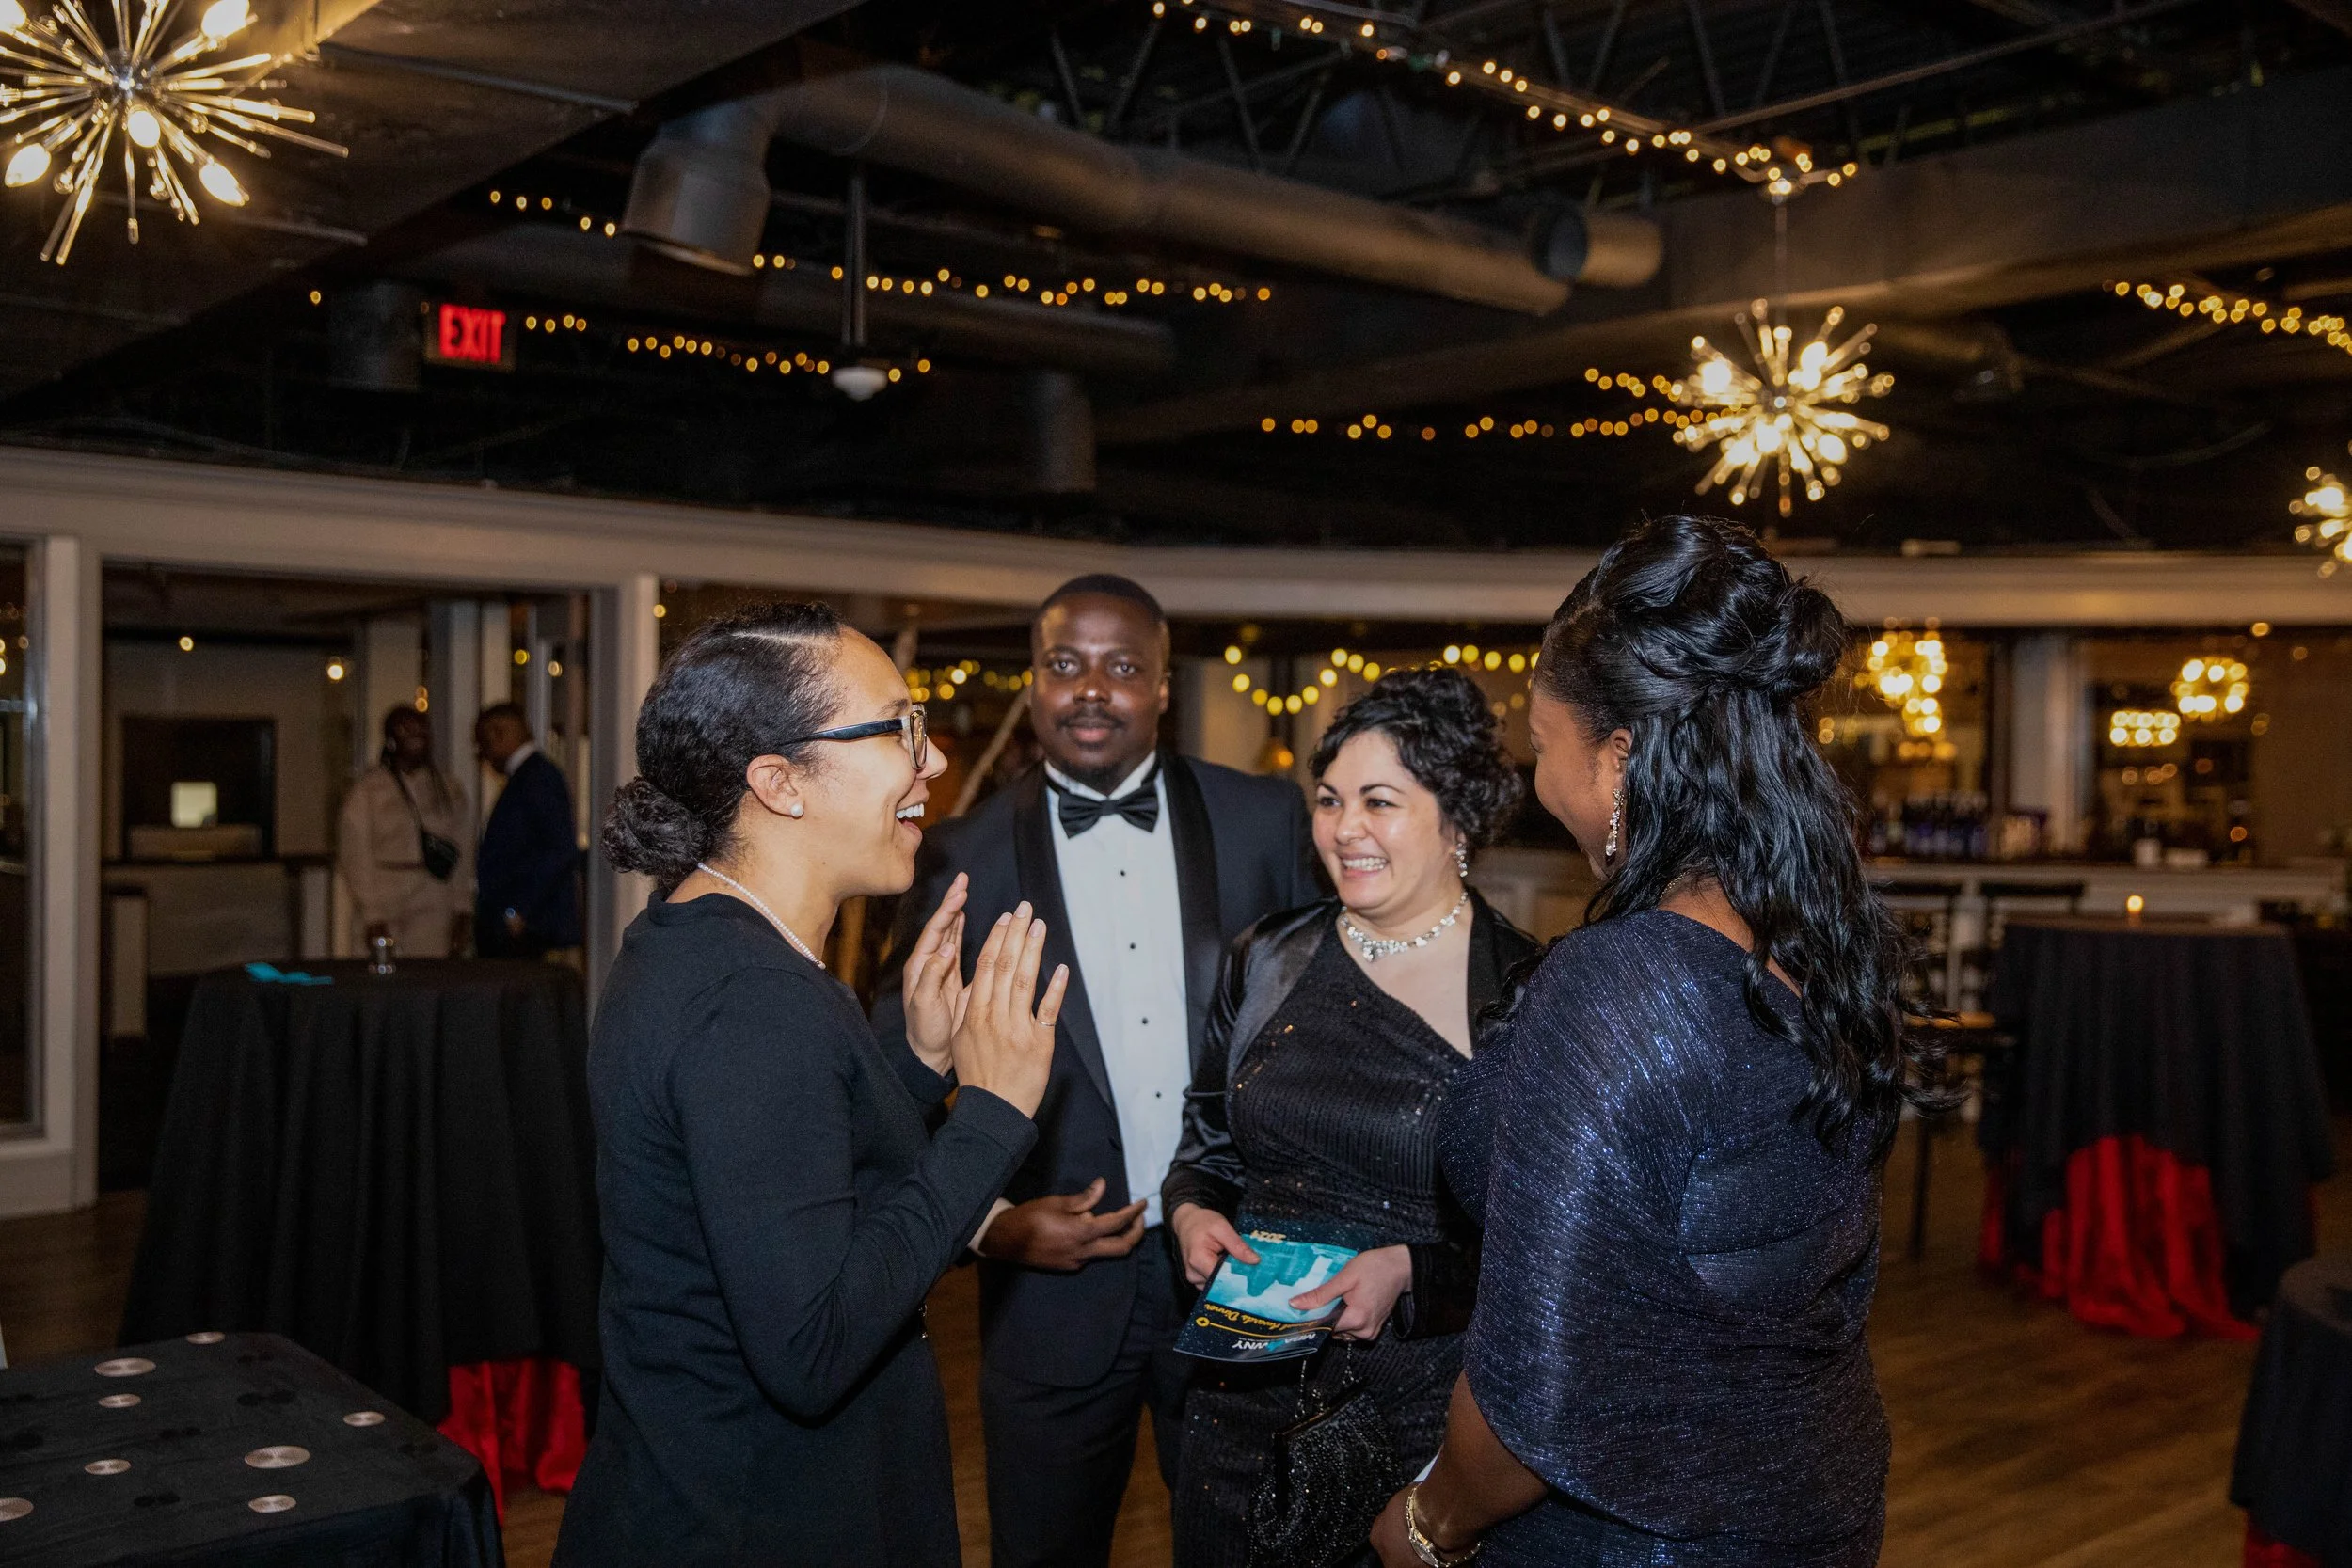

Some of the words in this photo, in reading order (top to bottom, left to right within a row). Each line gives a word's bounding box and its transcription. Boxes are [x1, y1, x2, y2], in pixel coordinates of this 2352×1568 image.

[439, 304, 506, 364] EXIT
[1204, 1304, 1240, 1321] Dinner
[1241, 1314, 1281, 1330] Awards
[1232, 1340, 1268, 1350] WNY
